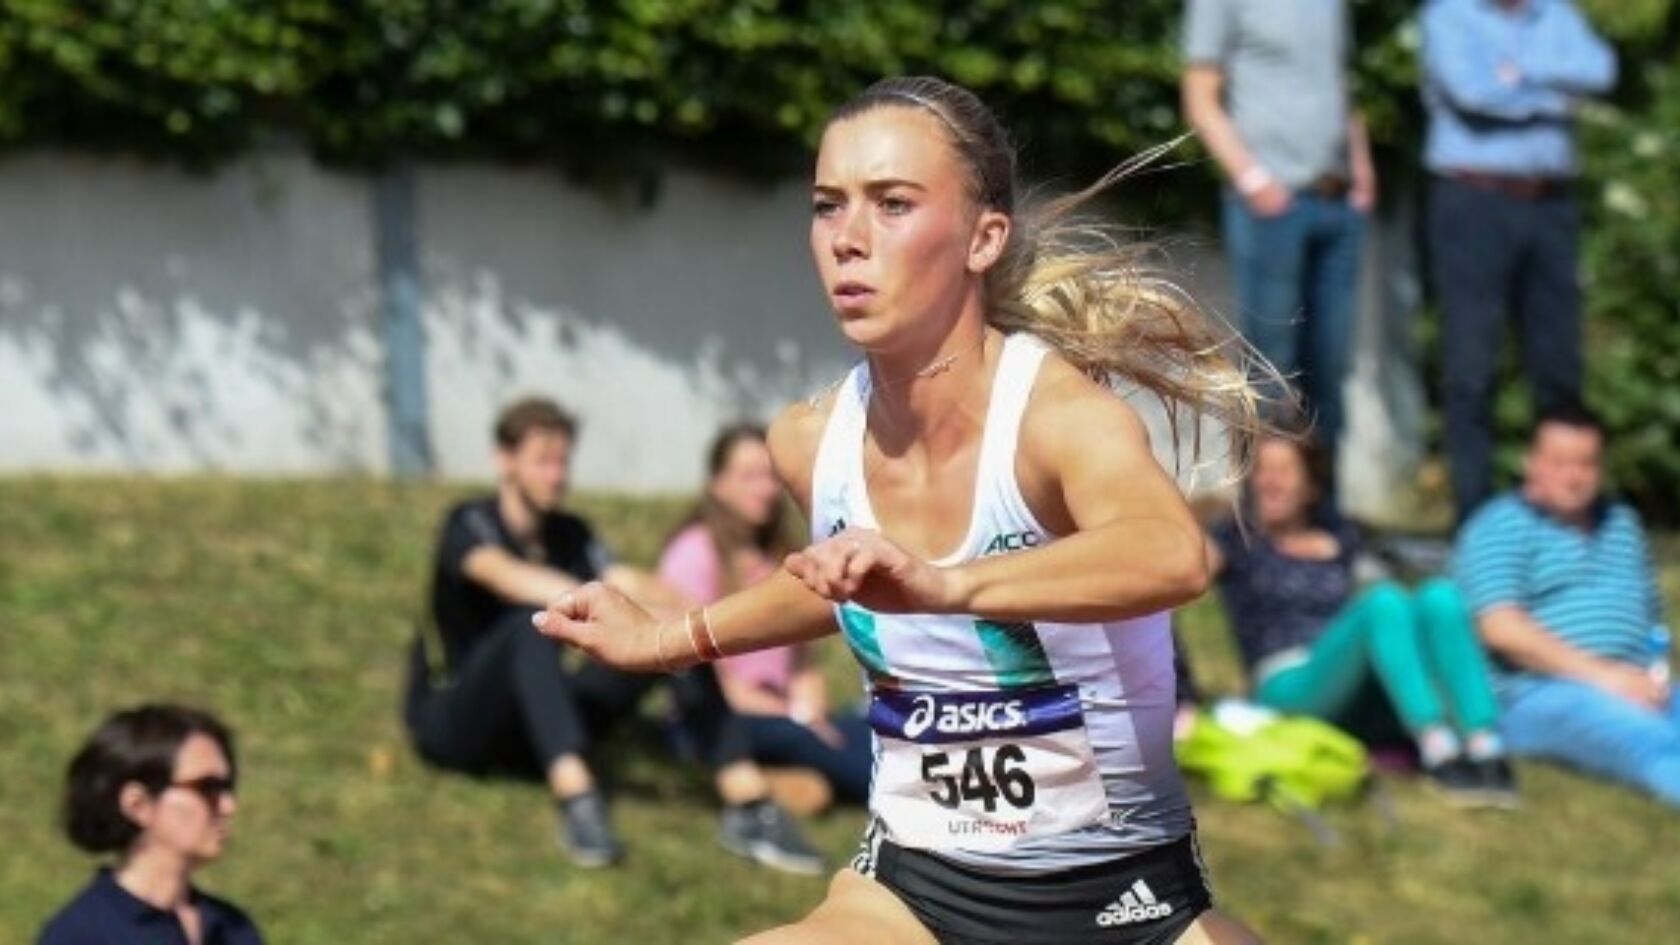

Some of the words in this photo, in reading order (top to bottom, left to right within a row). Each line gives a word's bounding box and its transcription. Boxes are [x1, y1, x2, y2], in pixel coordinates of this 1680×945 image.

[984, 531, 1037, 555] ACC
[921, 744, 1035, 812] 546
[1096, 902, 1172, 928] adidas
